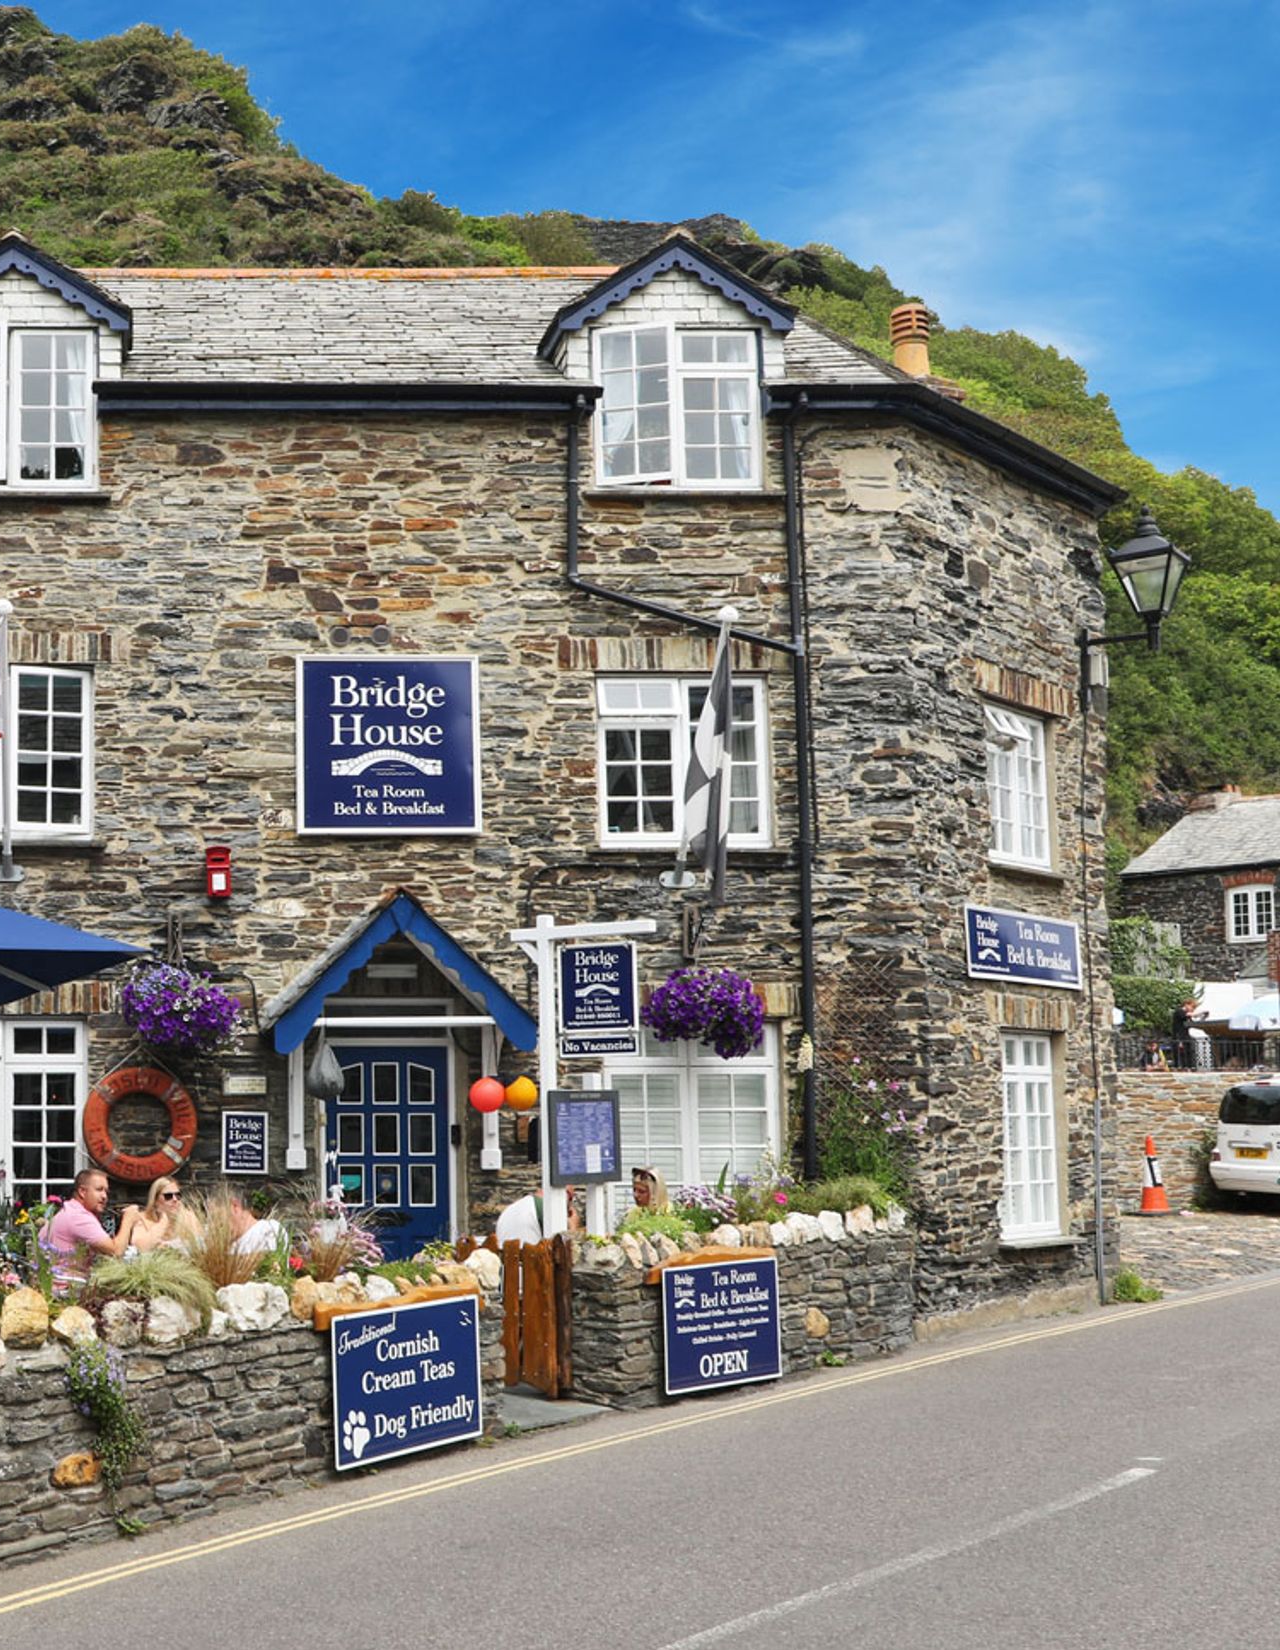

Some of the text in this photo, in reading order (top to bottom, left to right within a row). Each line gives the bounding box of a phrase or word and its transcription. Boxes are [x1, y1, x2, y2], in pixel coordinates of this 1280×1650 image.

[330, 676, 446, 718] Bridge
[330, 714, 443, 746] House
[353, 785, 425, 798] Tea Room
[334, 802, 446, 815] Bed & Breakfast
[976, 915, 999, 936] Bridge
[1017, 921, 1060, 945] Tea Room
[977, 932, 1000, 949] House
[576, 950, 619, 969] Bridge
[1007, 945, 1072, 972] Bed & Breakfast
[576, 968, 619, 984] House
[565, 1040, 634, 1052] No Vacancies
[230, 1119, 262, 1132] Bridge
[230, 1131, 262, 1141] House
[712, 1270, 757, 1286] Tea Room
[701, 1287, 769, 1309] Bed & Breakfast
[338, 1314, 396, 1355] Traditional
[376, 1330, 440, 1362] Cornish
[700, 1350, 749, 1378] OPEN
[361, 1360, 456, 1394] Cream Teas
[373, 1395, 475, 1439] Dog Friendly
